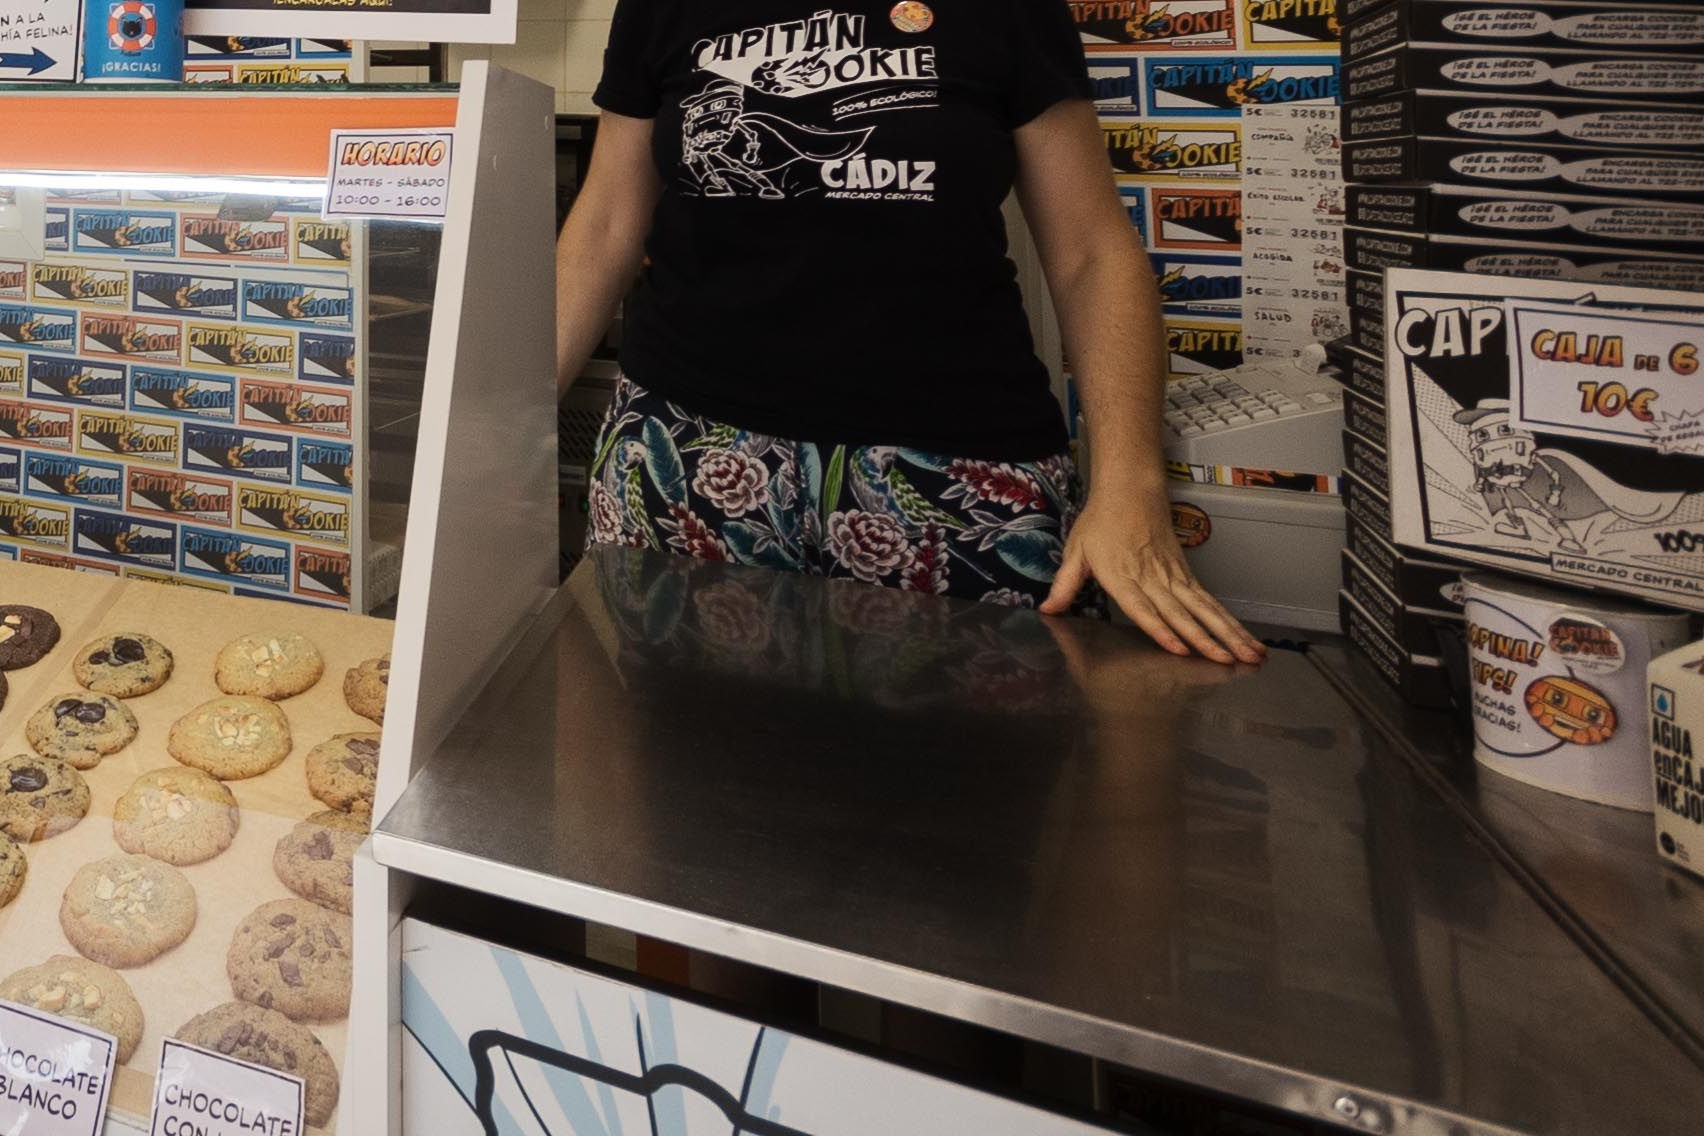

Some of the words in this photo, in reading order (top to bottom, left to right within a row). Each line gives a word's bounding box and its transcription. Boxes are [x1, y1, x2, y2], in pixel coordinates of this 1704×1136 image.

[25, 25, 73, 41] FELINA!
[691, 10, 866, 73] CAPITÁN
[102, 62, 161, 73] ¡GRACIAS!
[751, 46, 939, 95] COOKIE
[869, 90, 937, 108] ECOLÓGICO!
[1246, 108, 1263, 116] 5€
[341, 139, 446, 167] HORARIO
[337, 177, 383, 187] MARTES
[397, 177, 445, 188] SÁBADO
[821, 152, 936, 191] CÁDIZ
[336, 195, 379, 205] 10:00
[396, 196, 441, 207] 16:00
[825, 191, 881, 200] MERCADO
[884, 191, 935, 201] CENTRAL
[1531, 329, 1624, 368] CAJA
[1634, 354, 1660, 372] DE
[1669, 342, 1699, 376] 6
[1578, 380, 1658, 422] 10€
[1556, 559, 1629, 578] MERCADO
[1632, 571, 1703, 591] CENTRAL
[1653, 717, 1693, 760] AGUA
[165, 1083, 293, 1136] CHOCOLATE
